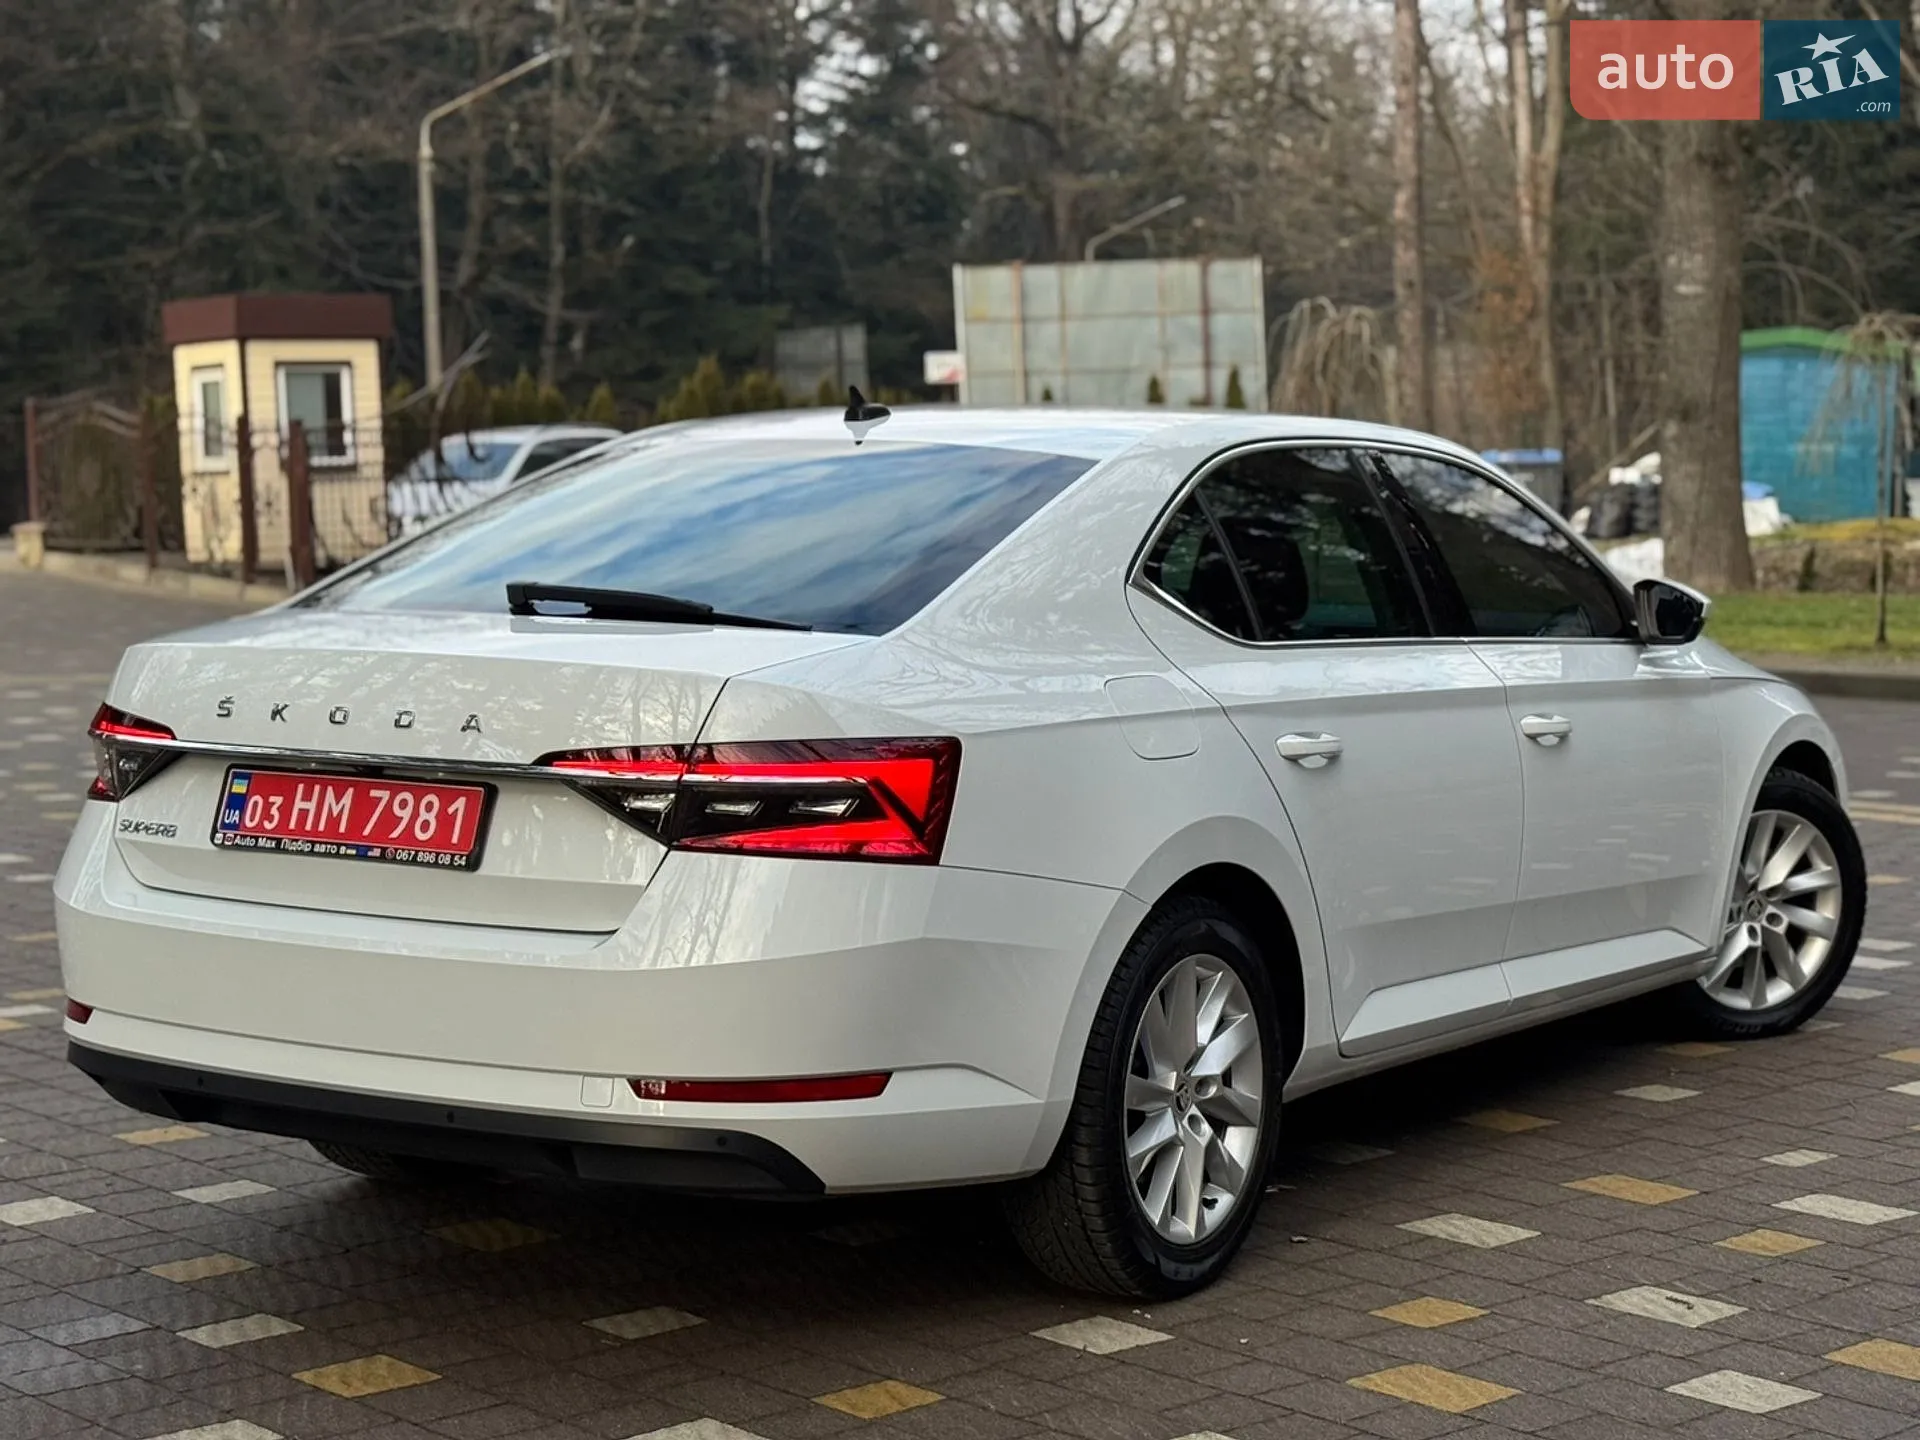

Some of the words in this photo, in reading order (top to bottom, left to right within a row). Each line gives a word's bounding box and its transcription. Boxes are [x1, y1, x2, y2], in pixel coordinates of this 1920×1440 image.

[223, 808, 241, 825] UA
[244, 794, 284, 830] 03
[362, 789, 467, 845] 7981
[119, 819, 178, 838] SUPERB
[233, 834, 256, 847] Auto
[257, 837, 277, 849] Max
[313, 843, 338, 854] авто
[396, 848, 416, 861] 067
[453, 856, 467, 866] 54
